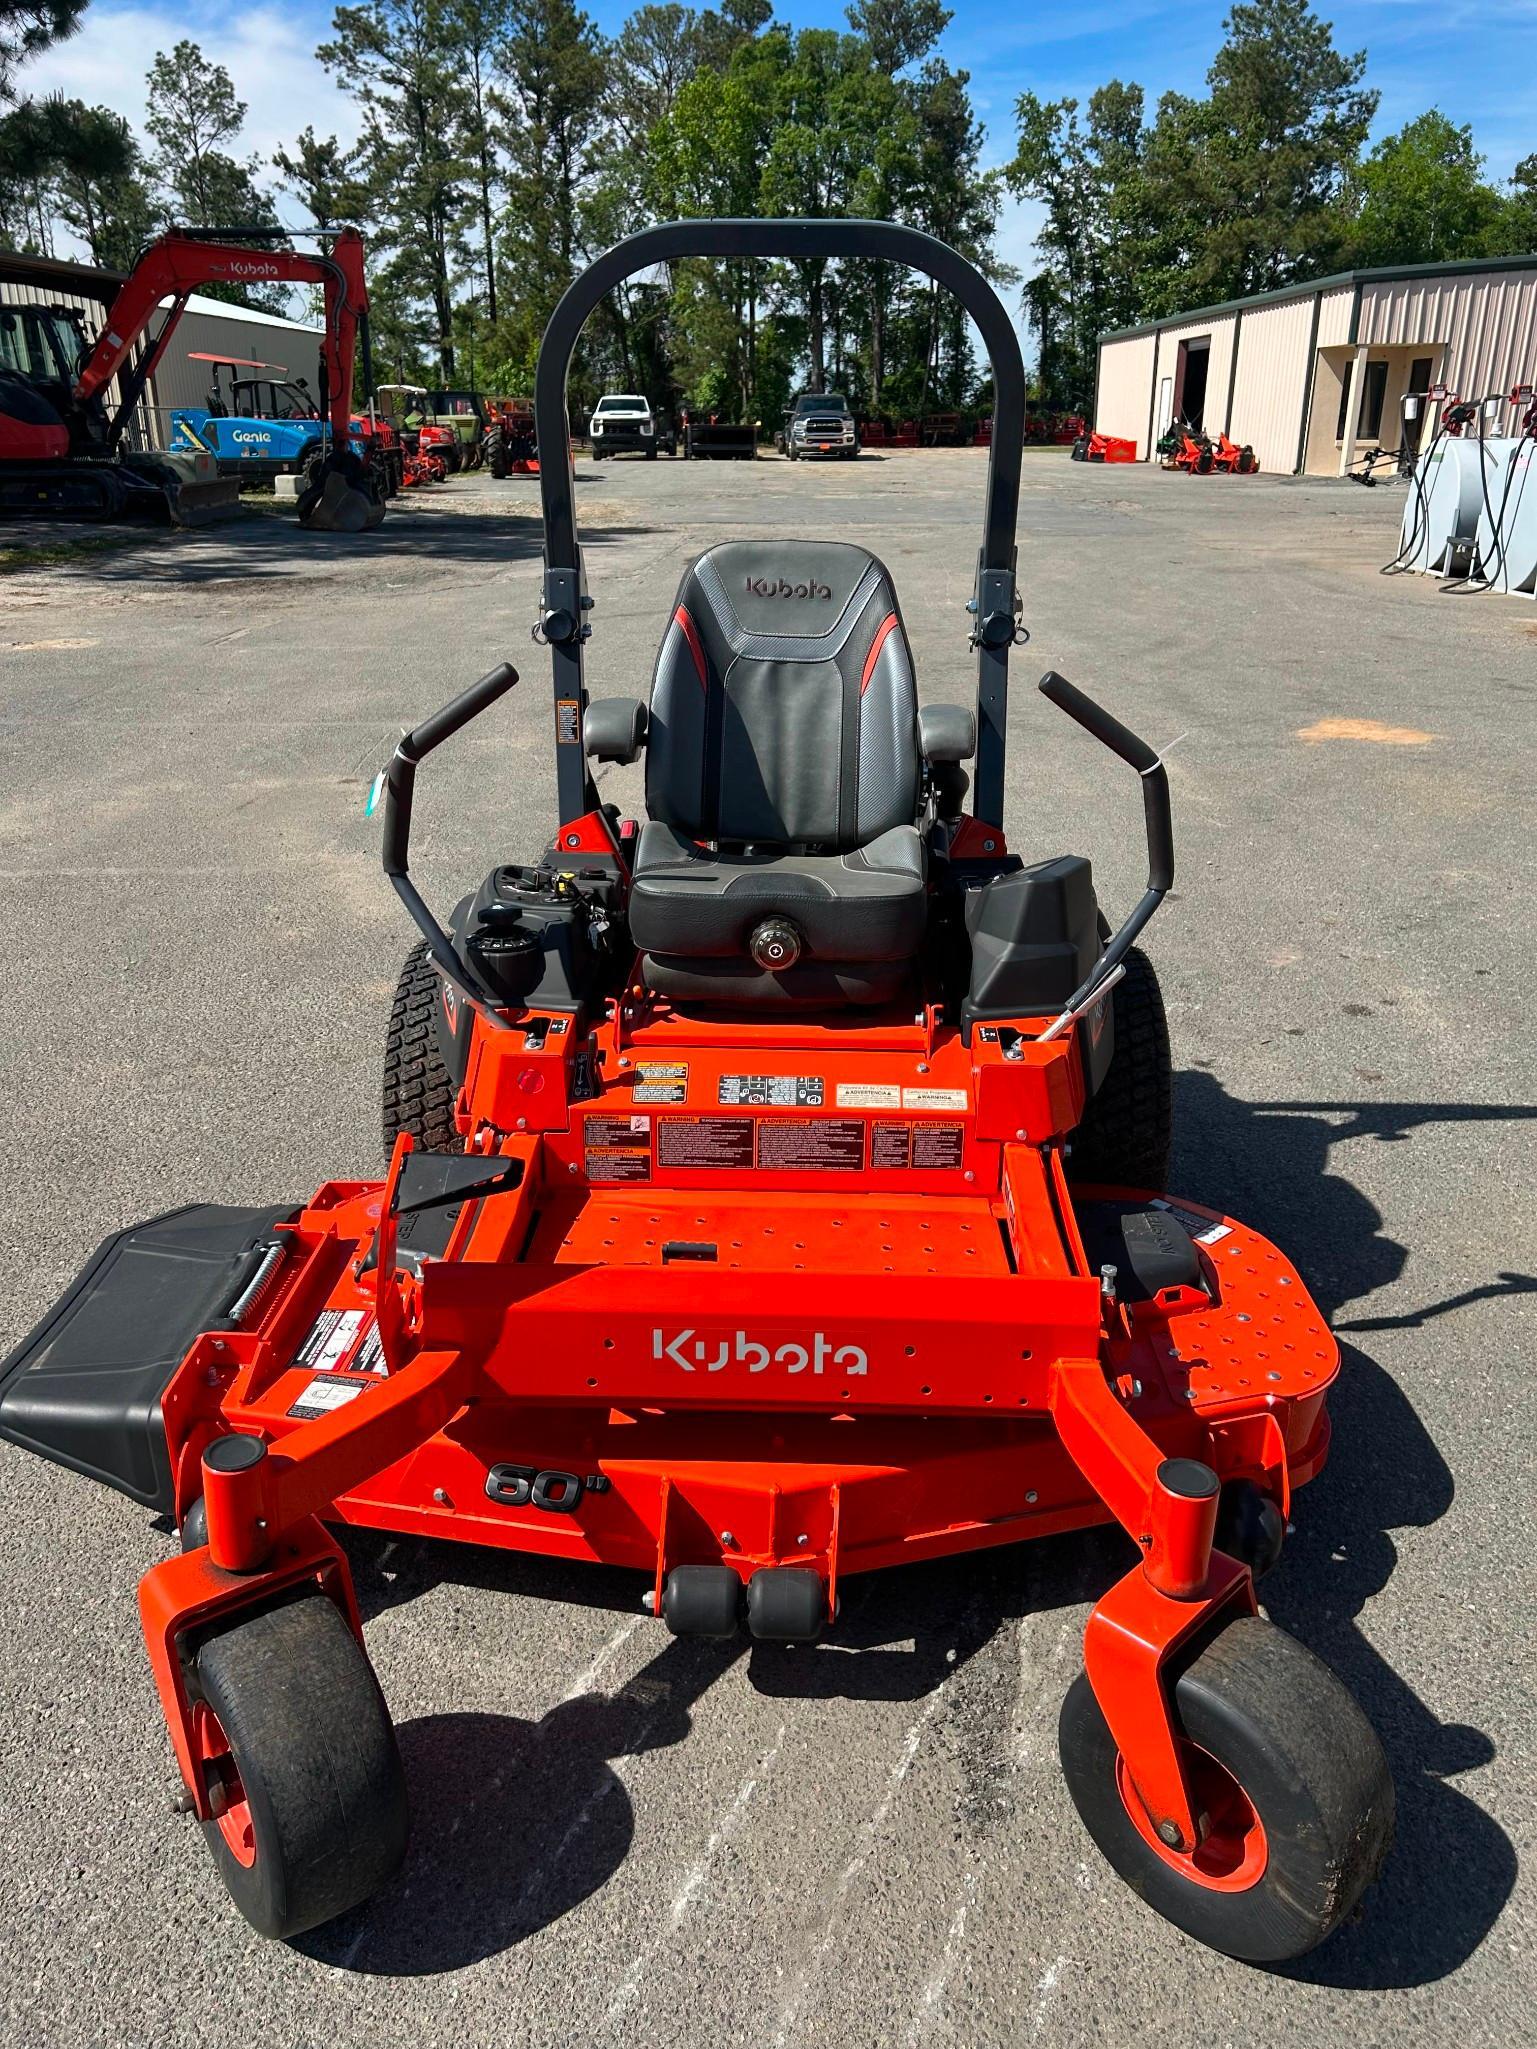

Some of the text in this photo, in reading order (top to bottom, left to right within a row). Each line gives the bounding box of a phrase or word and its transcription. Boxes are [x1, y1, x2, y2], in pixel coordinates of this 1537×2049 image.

[230, 262, 278, 275] Kubota
[232, 430, 272, 443] Genie
[746, 577, 833, 600] Kubota
[653, 1328, 868, 1375] Kubota
